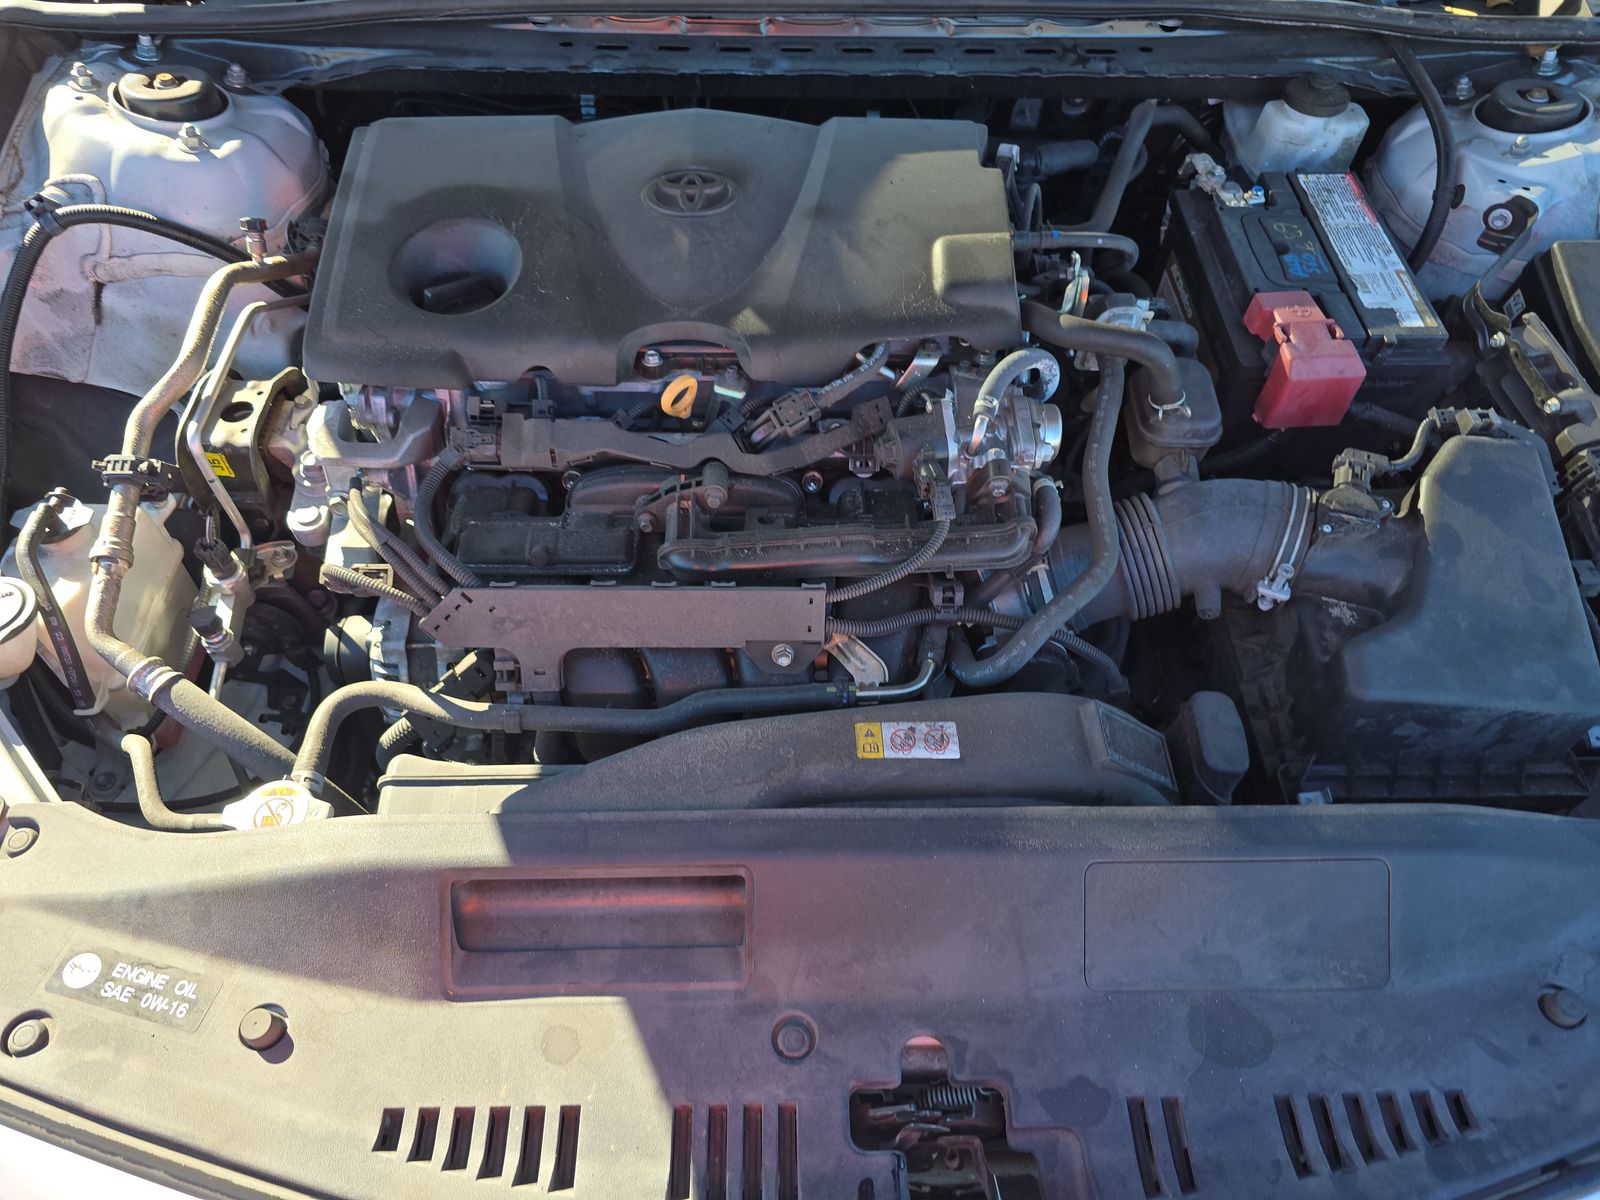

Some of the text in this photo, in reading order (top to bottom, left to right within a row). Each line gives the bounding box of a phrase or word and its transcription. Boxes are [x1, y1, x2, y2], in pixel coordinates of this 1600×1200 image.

[112, 962, 198, 999] ENGINE OIL
[100, 982, 189, 1018] SAE 0W-16
